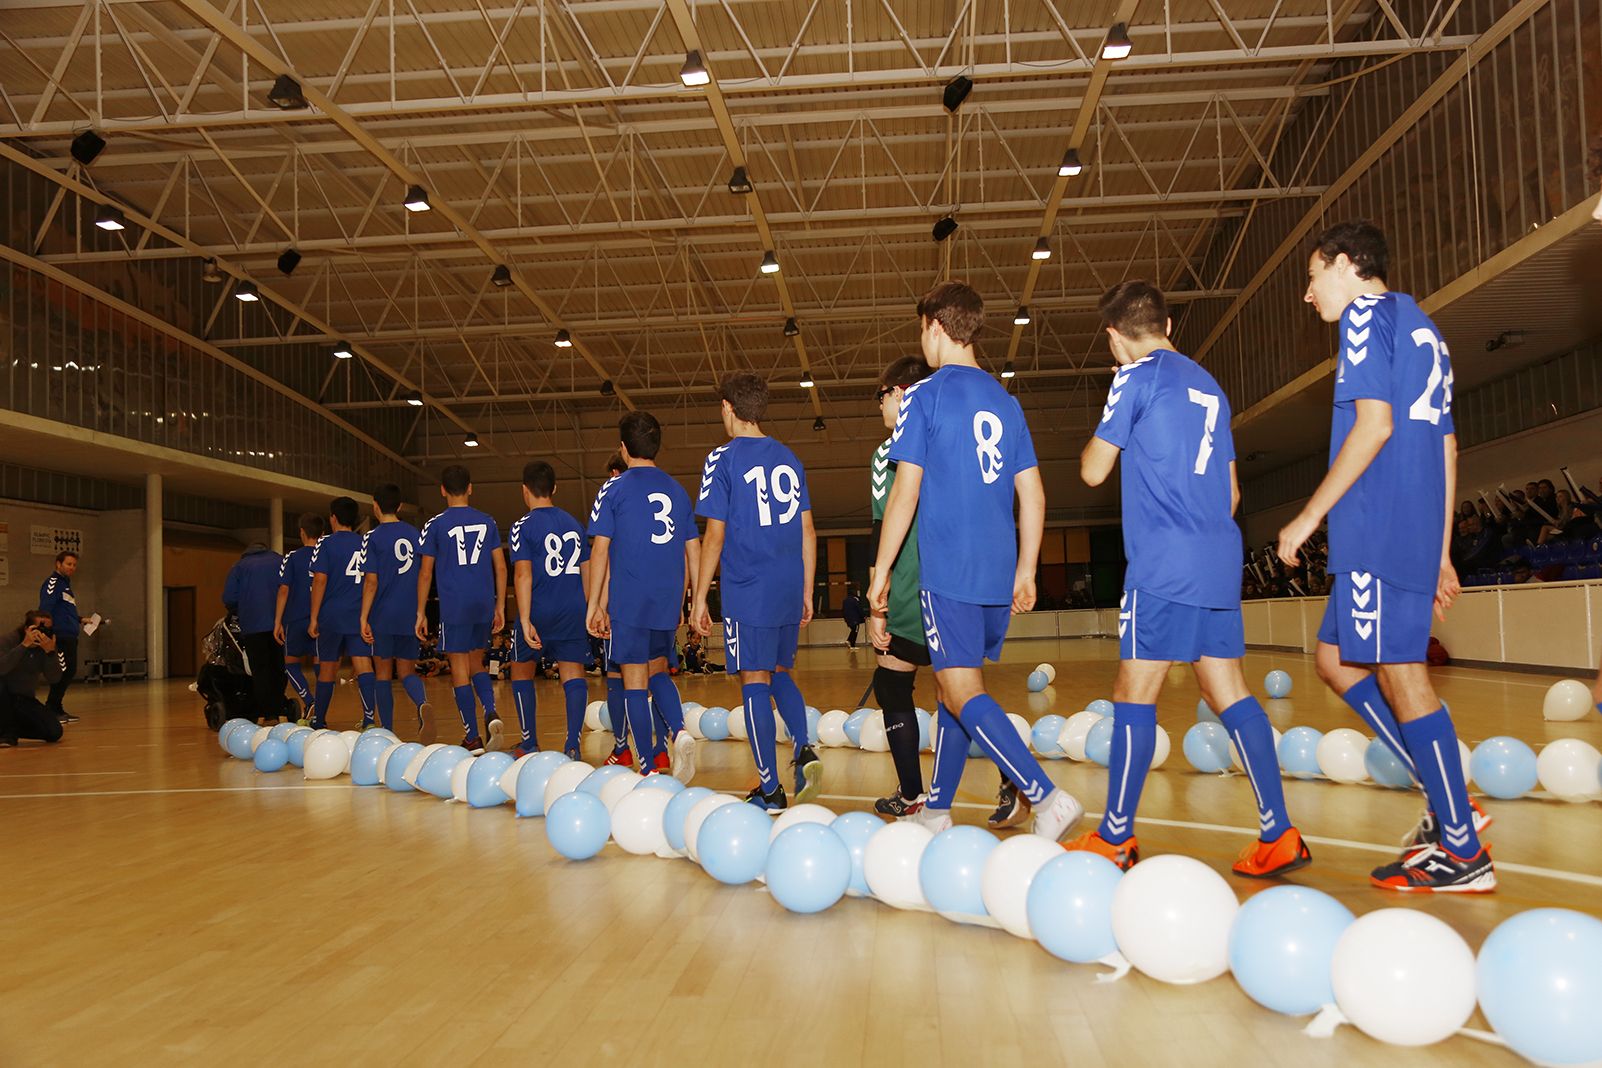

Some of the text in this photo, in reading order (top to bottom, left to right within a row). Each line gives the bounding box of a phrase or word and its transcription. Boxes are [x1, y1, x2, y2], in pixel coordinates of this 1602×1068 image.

[973, 410, 1003, 484] 8
[1187, 388, 1220, 475] 7
[647, 492, 675, 545] 3
[743, 464, 801, 527] 19
[345, 551, 364, 584] 4
[394, 538, 414, 575] 9
[448, 523, 488, 566] 17
[544, 530, 582, 577] 82
